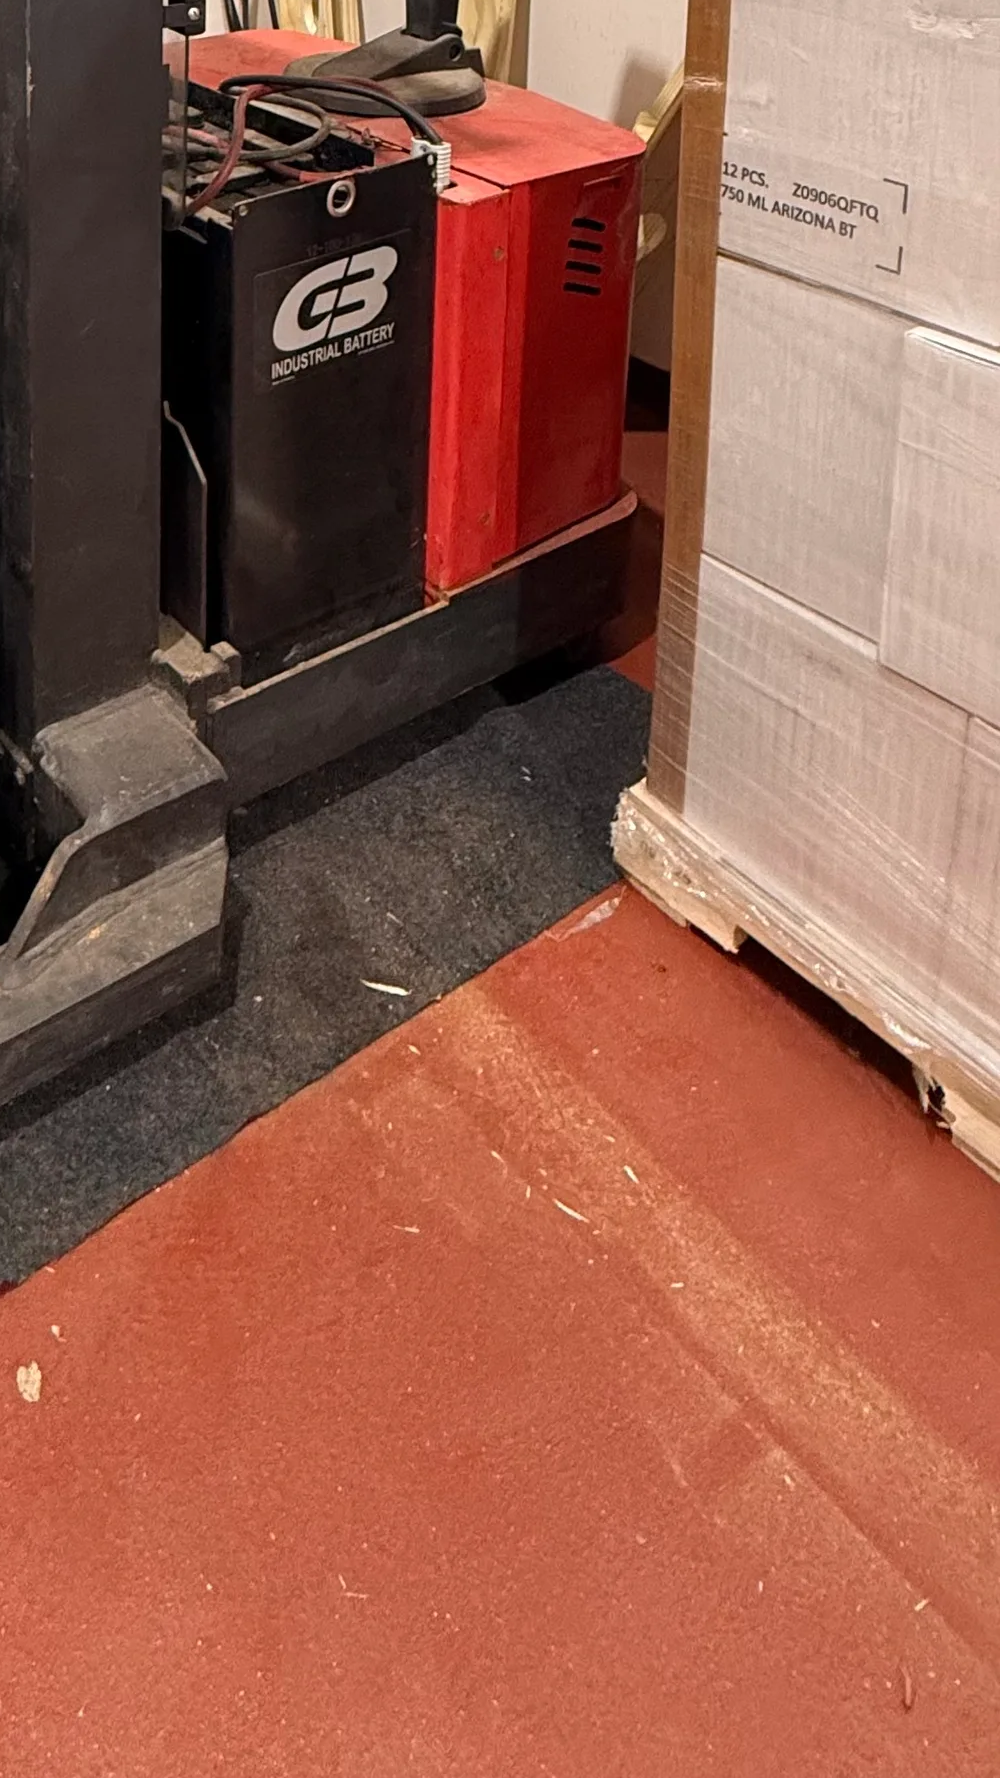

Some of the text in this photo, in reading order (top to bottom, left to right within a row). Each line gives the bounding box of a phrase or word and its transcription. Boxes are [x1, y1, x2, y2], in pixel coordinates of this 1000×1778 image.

[723, 162, 737, 178] 12
[741, 167, 769, 188] PCS.
[721, 184, 857, 239] 750 ML ARIZONA BT
[271, 342, 342, 379] INDUSTRIAL
[343, 322, 395, 354] BATTERY
